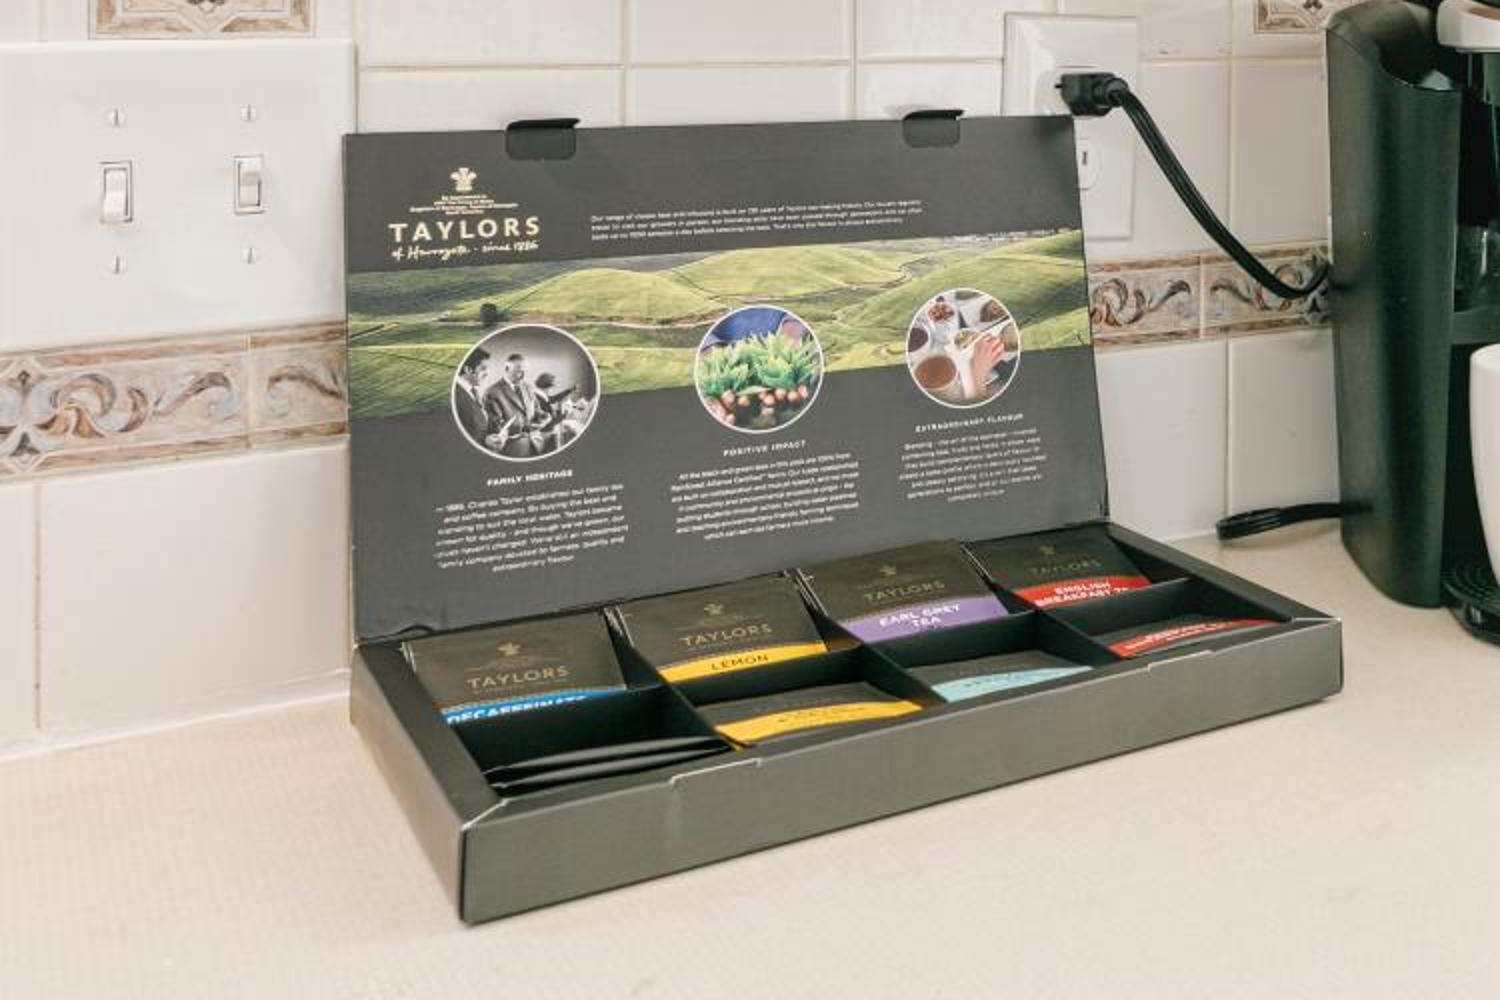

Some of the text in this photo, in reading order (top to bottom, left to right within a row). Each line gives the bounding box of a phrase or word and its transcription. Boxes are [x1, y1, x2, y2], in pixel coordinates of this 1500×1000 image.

[387, 216, 540, 243] TAYLORS
[723, 440, 806, 457] POSITIVE IMPACT
[486, 469, 574, 487] FAMILY HERITAGE
[864, 580, 945, 601] TAYLORS
[1055, 582, 1111, 595] ENGLISH
[879, 603, 960, 627] EARL GREY
[912, 616, 941, 630] TEA
[679, 623, 773, 647] TAYLORS
[711, 653, 769, 671] LEMON
[466, 665, 569, 690] TAYLORS
